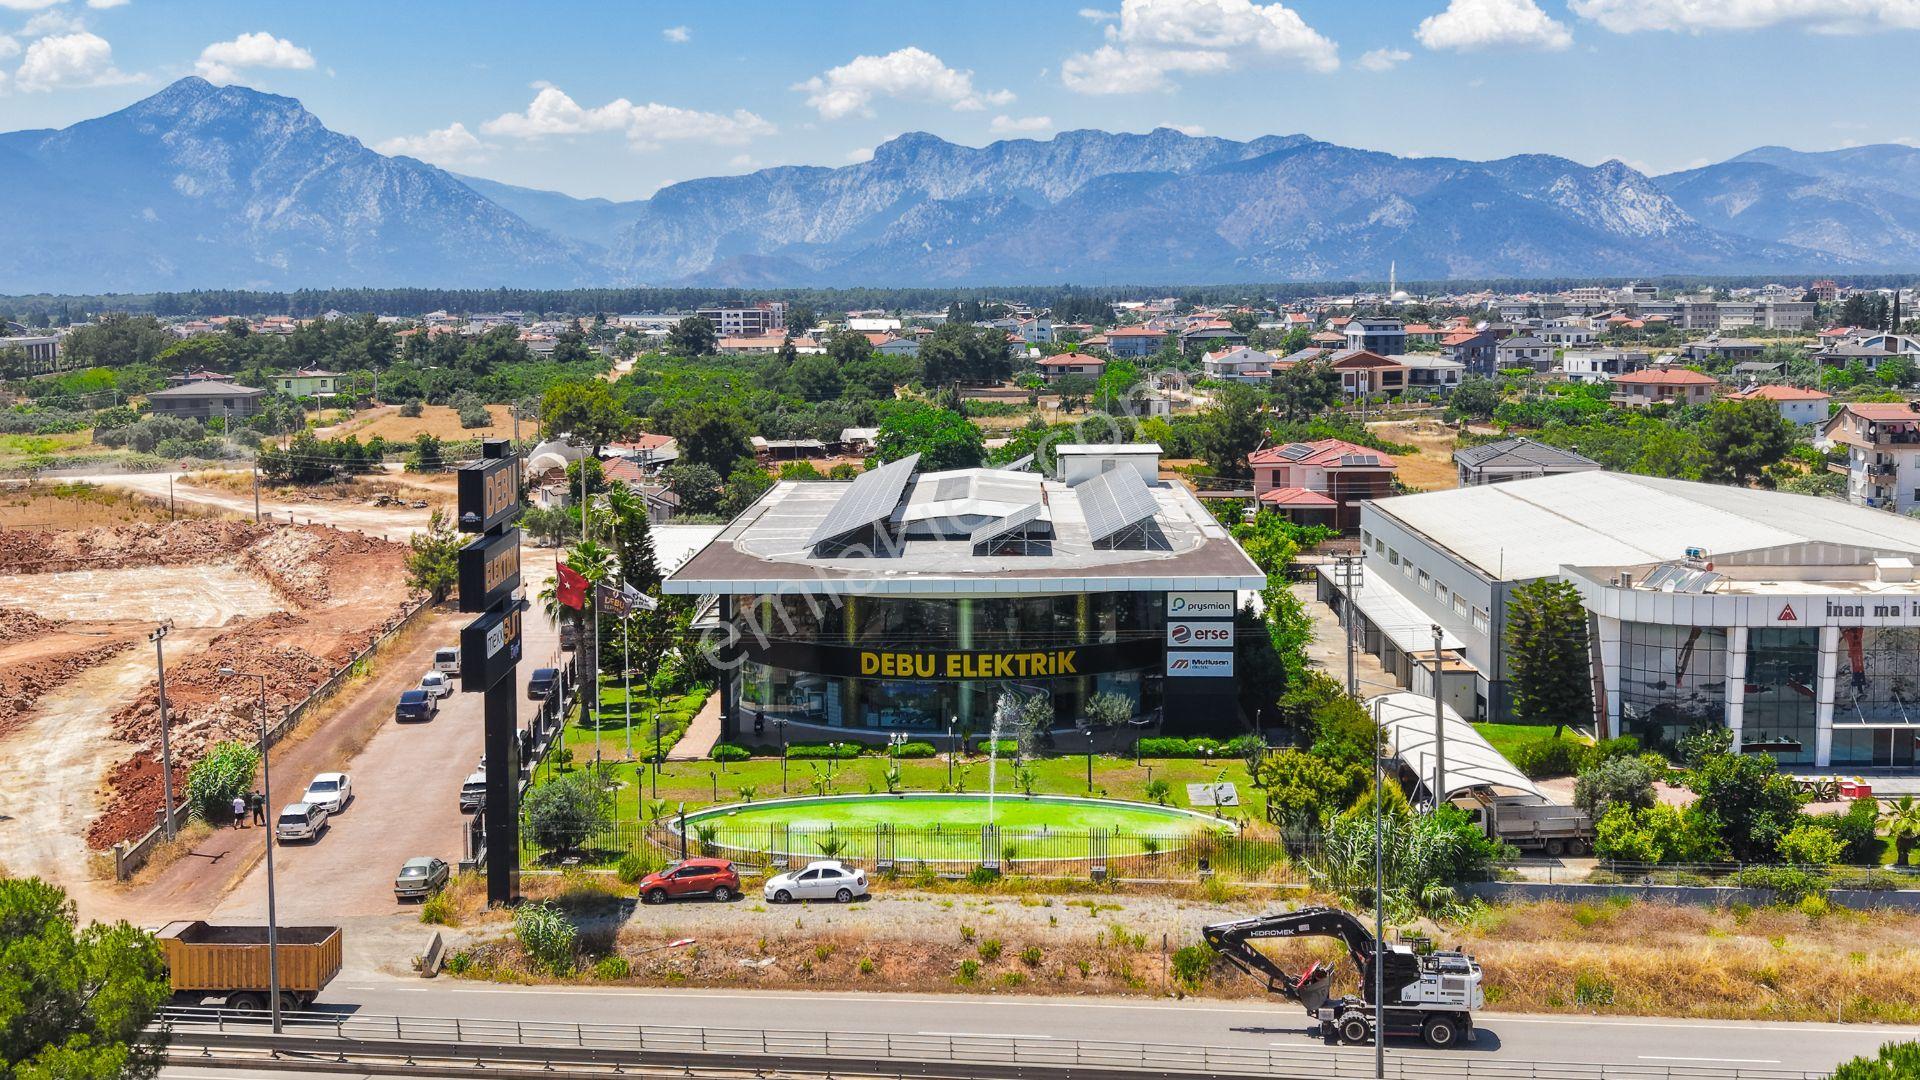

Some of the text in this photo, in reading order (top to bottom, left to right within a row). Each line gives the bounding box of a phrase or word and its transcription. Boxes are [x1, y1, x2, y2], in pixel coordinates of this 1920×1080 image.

[486, 463, 517, 519] DEBU
[1187, 602, 1231, 612] prysmian
[1194, 629, 1229, 640] erse
[861, 652, 936, 677] DEBU
